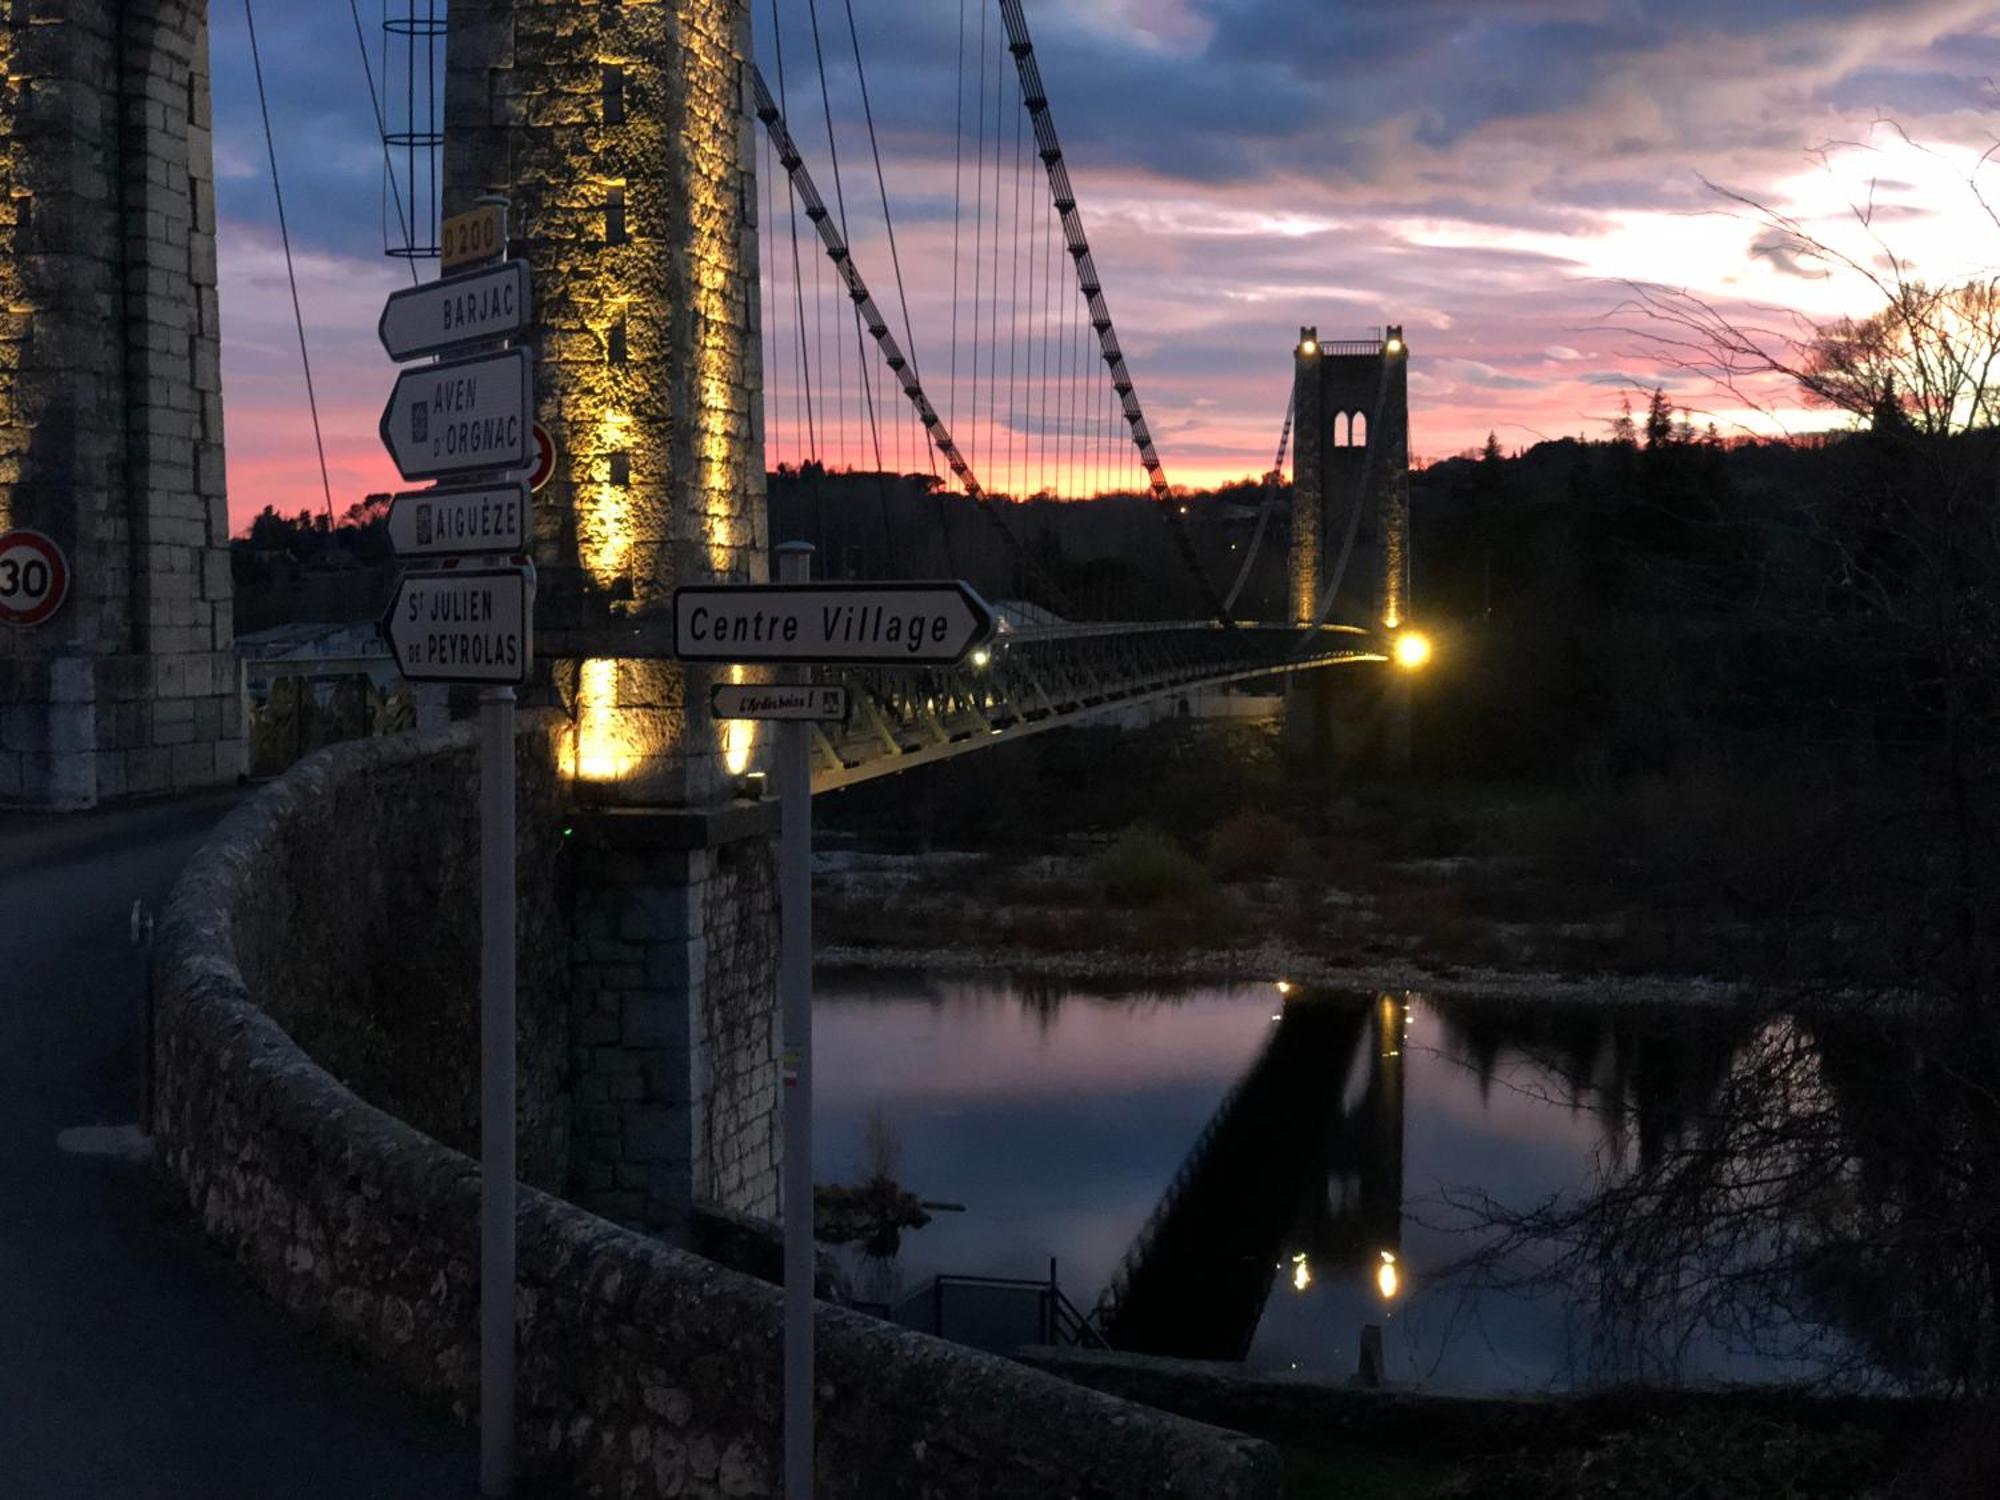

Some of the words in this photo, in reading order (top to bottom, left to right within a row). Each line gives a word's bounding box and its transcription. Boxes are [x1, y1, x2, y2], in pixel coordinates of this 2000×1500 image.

[459, 216, 494, 254] 200
[444, 284, 513, 330] BARJAC
[433, 379, 477, 413] AVEN
[437, 497, 515, 539] AIGUÈZE
[0, 560, 47, 597] 30
[430, 591, 492, 621] JULIEN
[690, 607, 798, 641] Centre
[822, 606, 948, 652] Village
[409, 641, 421, 663] DE
[428, 636, 516, 665] PEYROLAS
